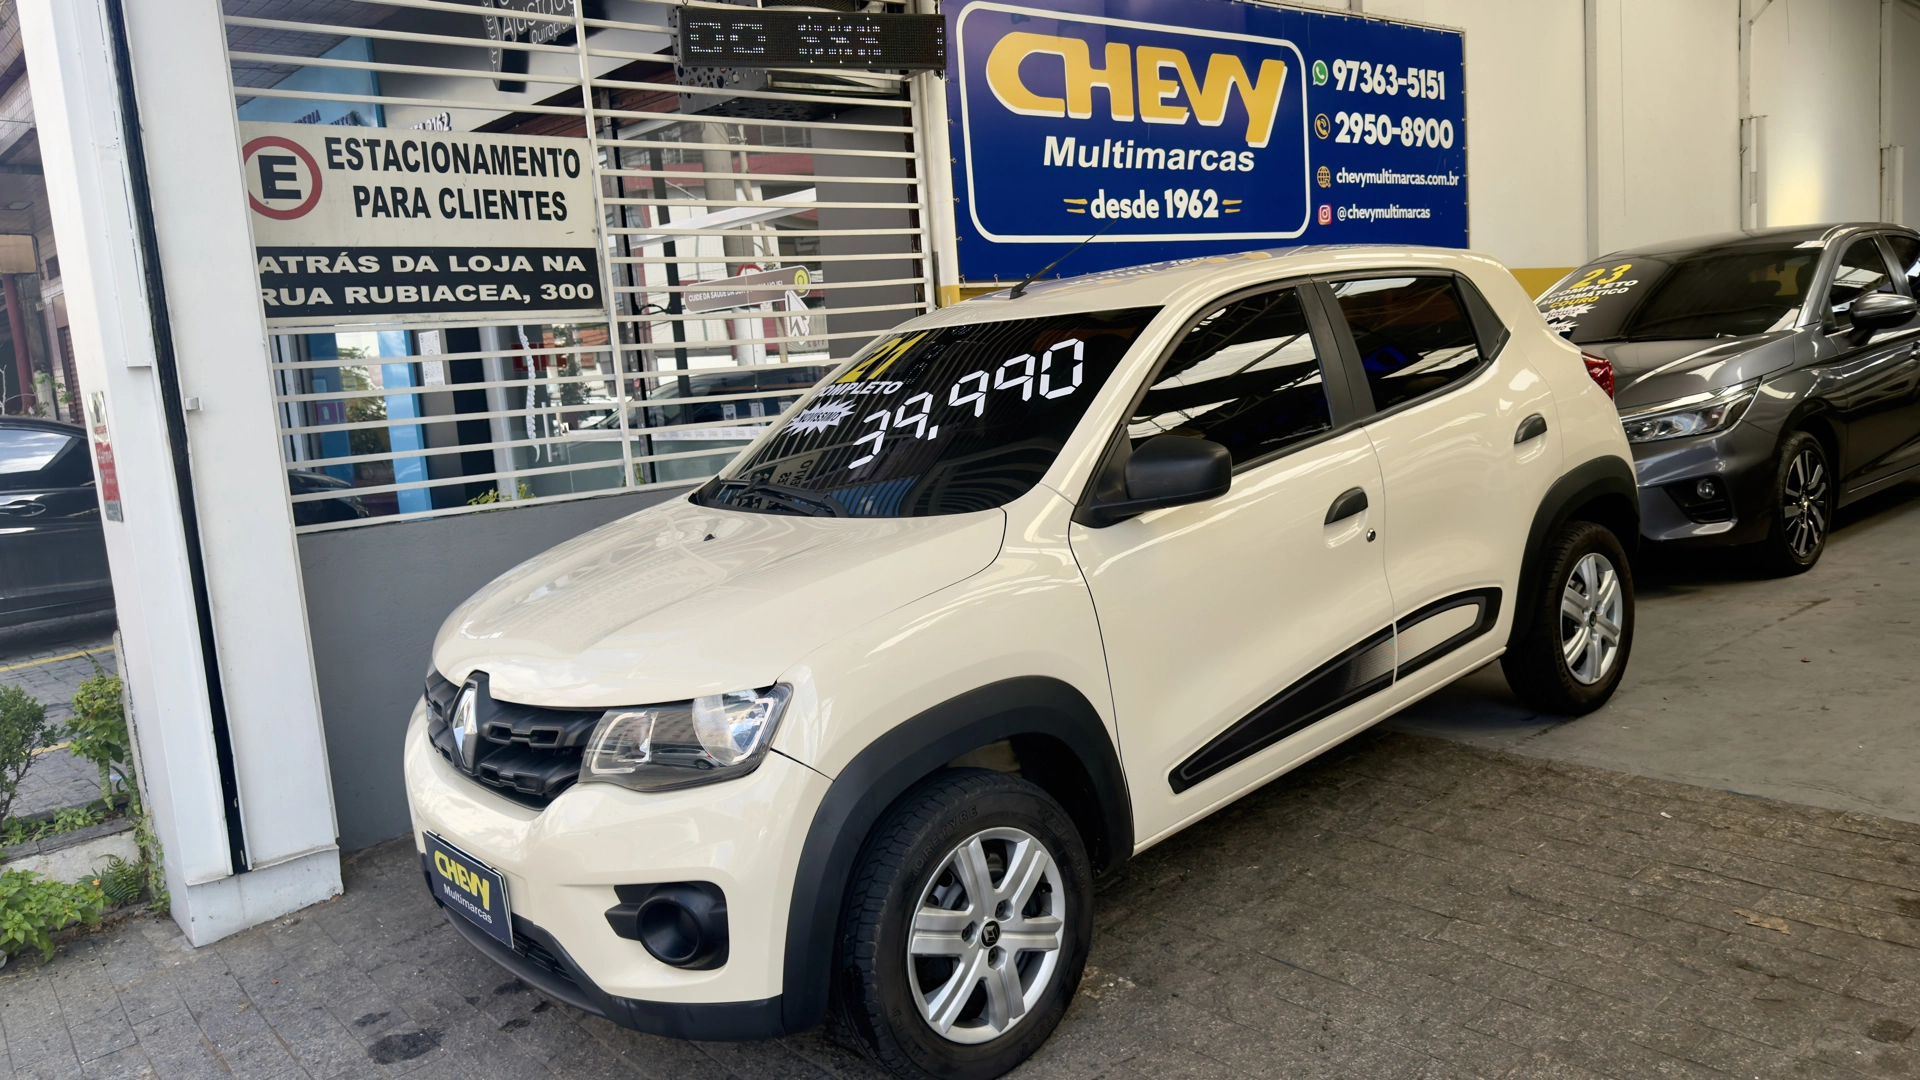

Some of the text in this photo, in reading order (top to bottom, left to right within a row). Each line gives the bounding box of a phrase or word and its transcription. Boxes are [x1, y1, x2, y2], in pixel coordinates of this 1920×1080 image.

[986, 31, 1288, 148] CHEVY
[1332, 58, 1446, 101] 97363-5151
[1334, 111, 1454, 149] 2950-8900
[324, 136, 581, 179] ESTACIONAMENTO
[1043, 135, 1255, 172] Multimarcas
[257, 154, 302, 200] E
[1336, 167, 1460, 188] chevymultimarcas.com.br
[352, 185, 568, 222] PARA CLIENTES
[1090, 188, 1219, 219] desde 1962
[1337, 203, 1431, 222] @chevymultimarcas
[257, 252, 587, 274] ATRÁS DA LOJA NA
[1568, 264, 1632, 289] 23
[260, 283, 594, 306] RUA RUBIACEA, 300
[1548, 279, 1639, 299] COMPLETO
[1549, 296, 1600, 309] COURO
[835, 331, 930, 384] 21
[811, 380, 905, 399] COMPLETO
[434, 850, 490, 912] CHEVY
[443, 883, 493, 924] Multimarcas
